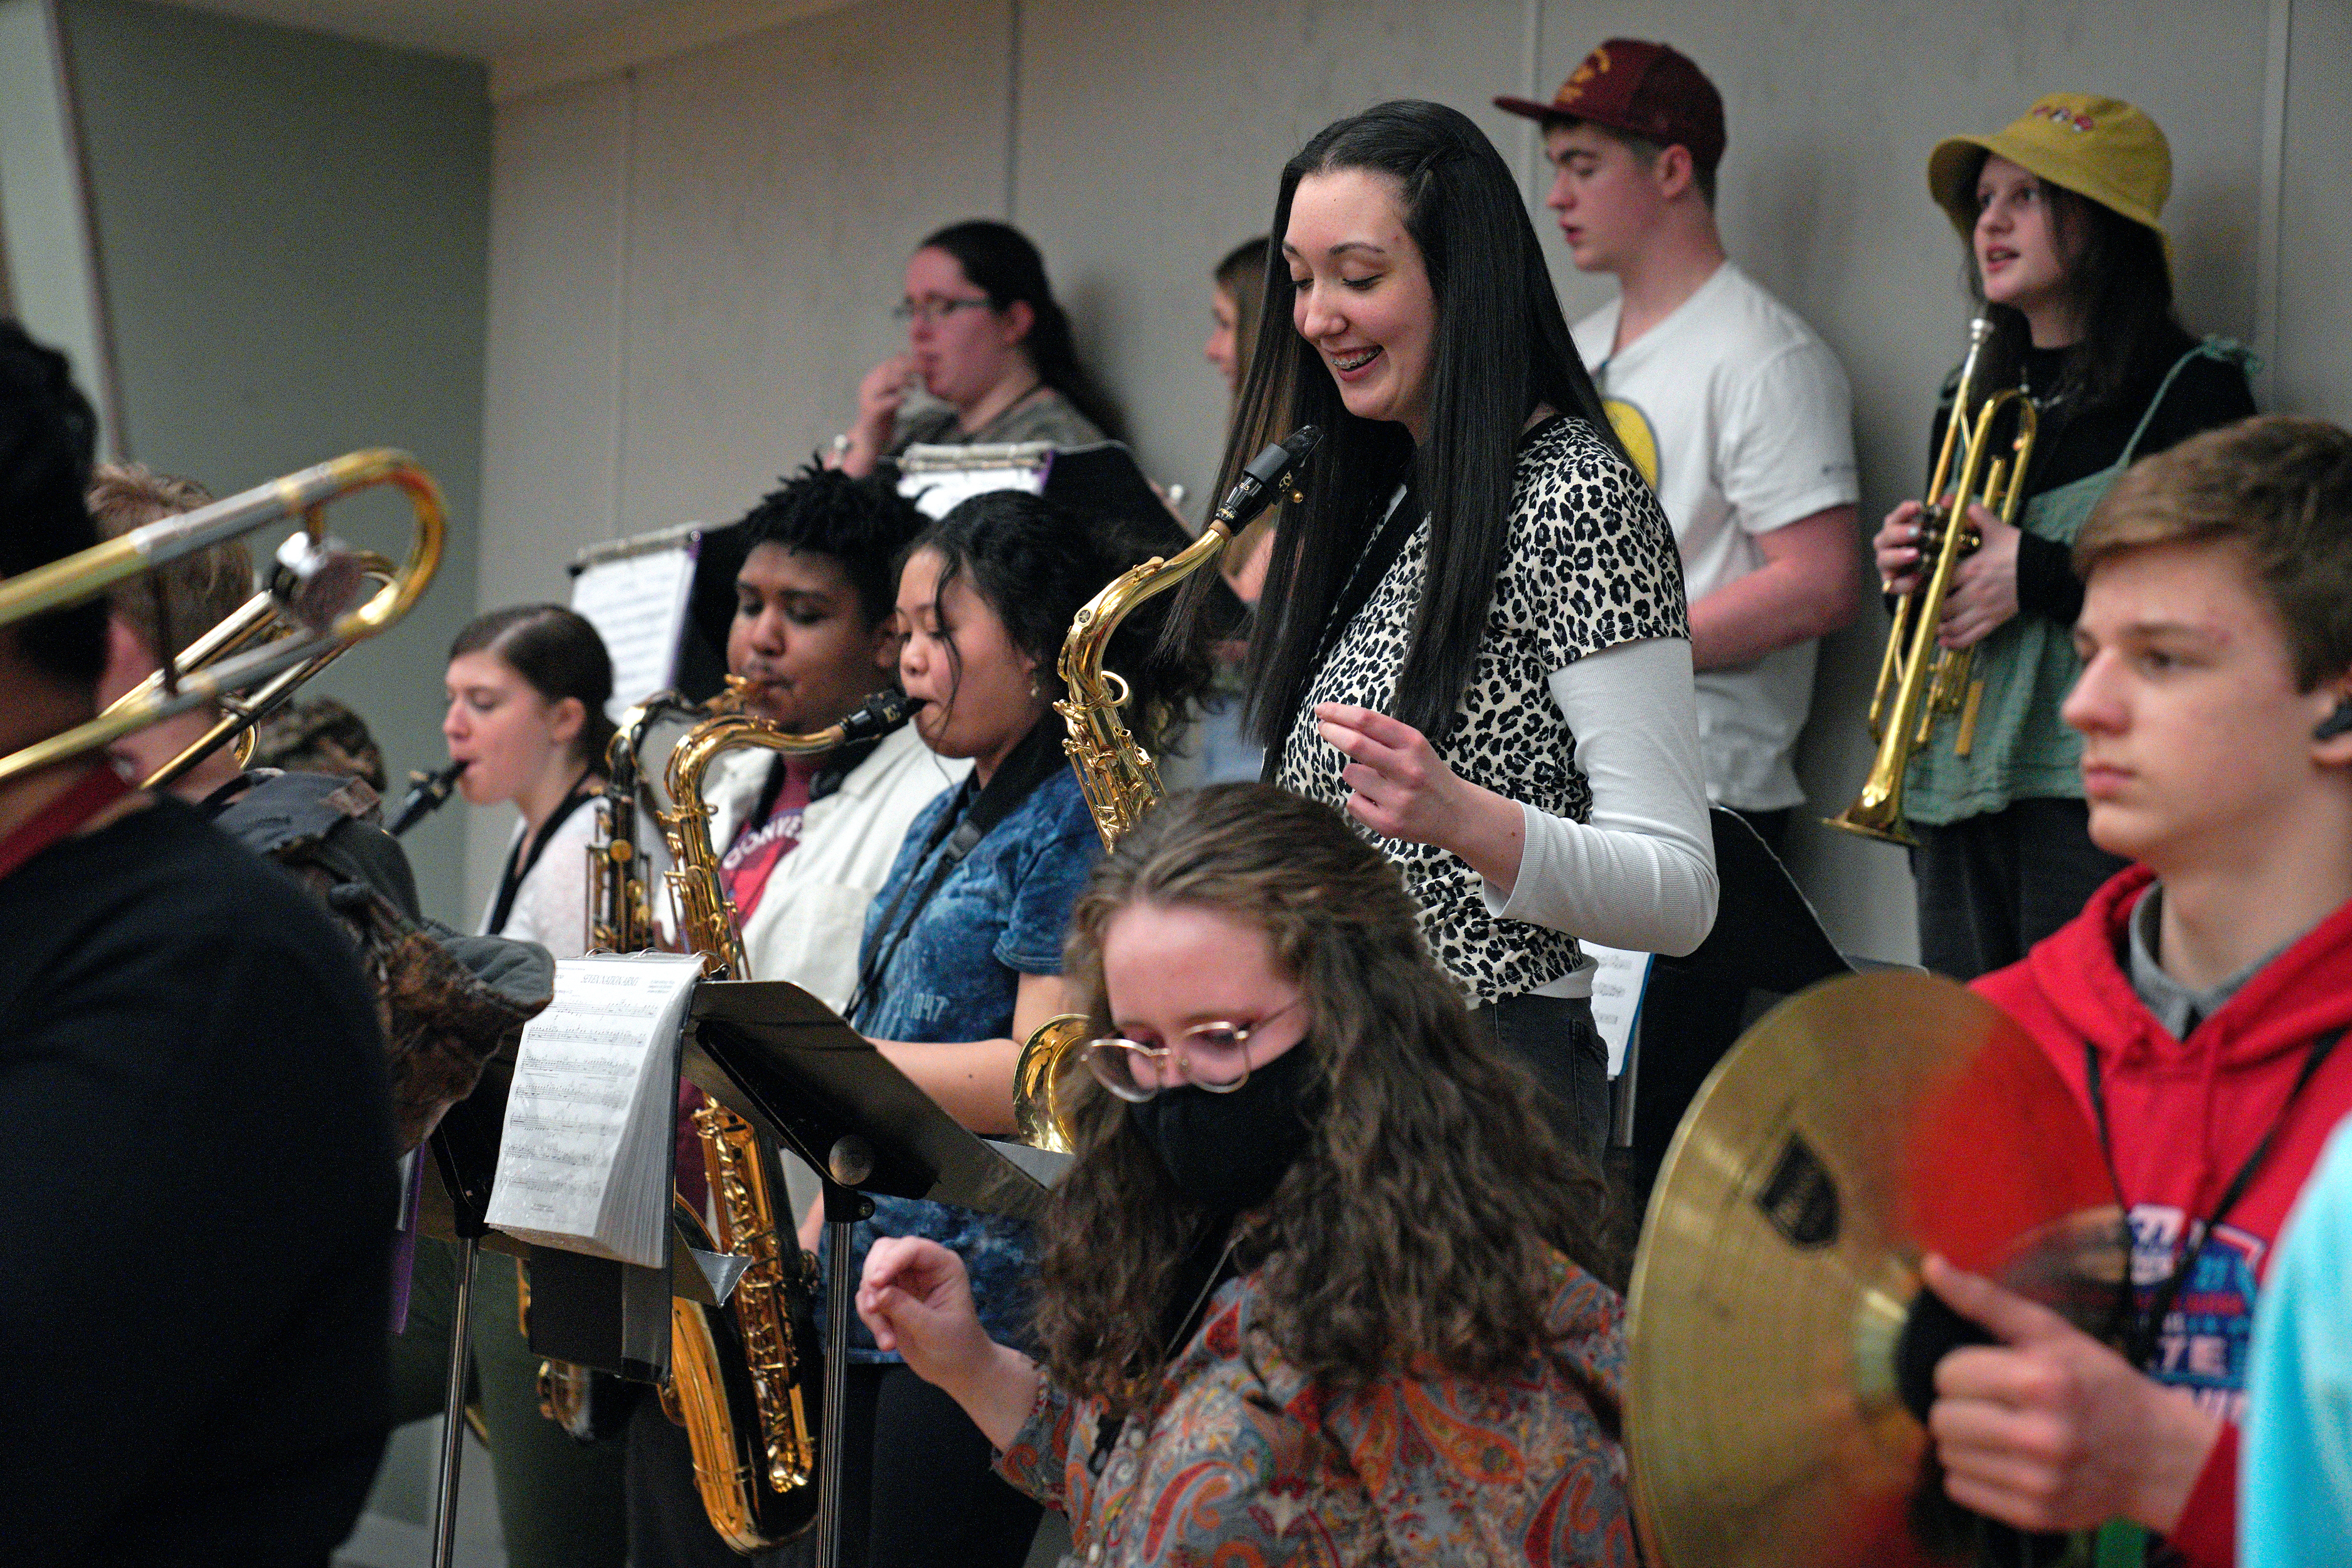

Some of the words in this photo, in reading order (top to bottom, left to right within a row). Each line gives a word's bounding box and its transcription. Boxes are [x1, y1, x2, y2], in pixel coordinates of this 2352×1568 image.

[580, 973, 601, 984] SEVEN
[600, 975, 623, 986] NATION
[620, 976, 641, 987] ARMY
